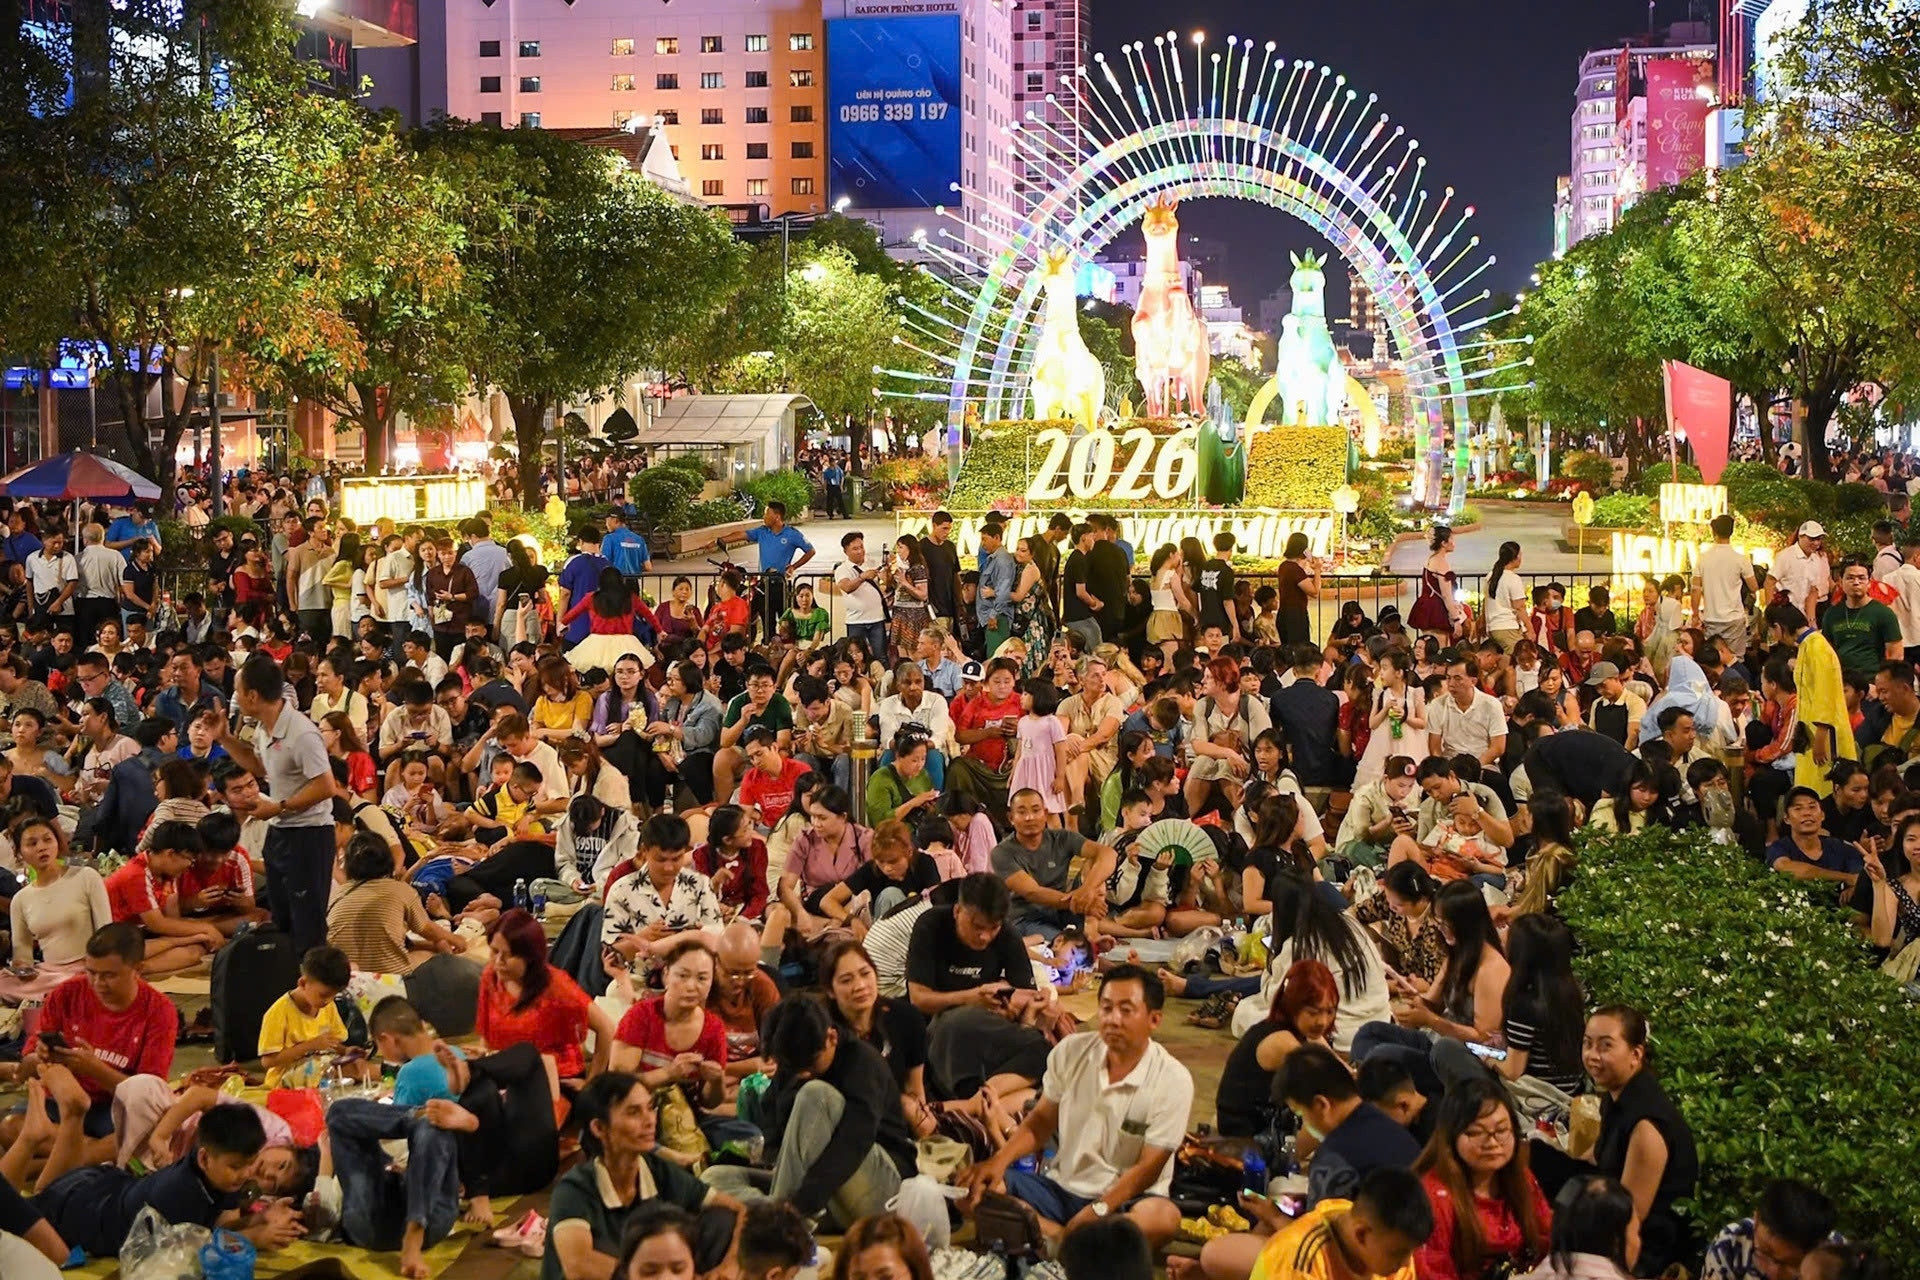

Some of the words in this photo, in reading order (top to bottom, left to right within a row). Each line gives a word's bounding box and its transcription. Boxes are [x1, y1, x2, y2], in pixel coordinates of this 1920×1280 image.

[855, 6, 889, 14] SAIGON
[891, 4, 925, 13] PRINCE
[926, 3, 958, 12] HOTEL
[840, 104, 879, 122] 0966
[884, 103, 914, 121] 339
[920, 102, 948, 120] 197
[1025, 427, 1199, 500] 2026
